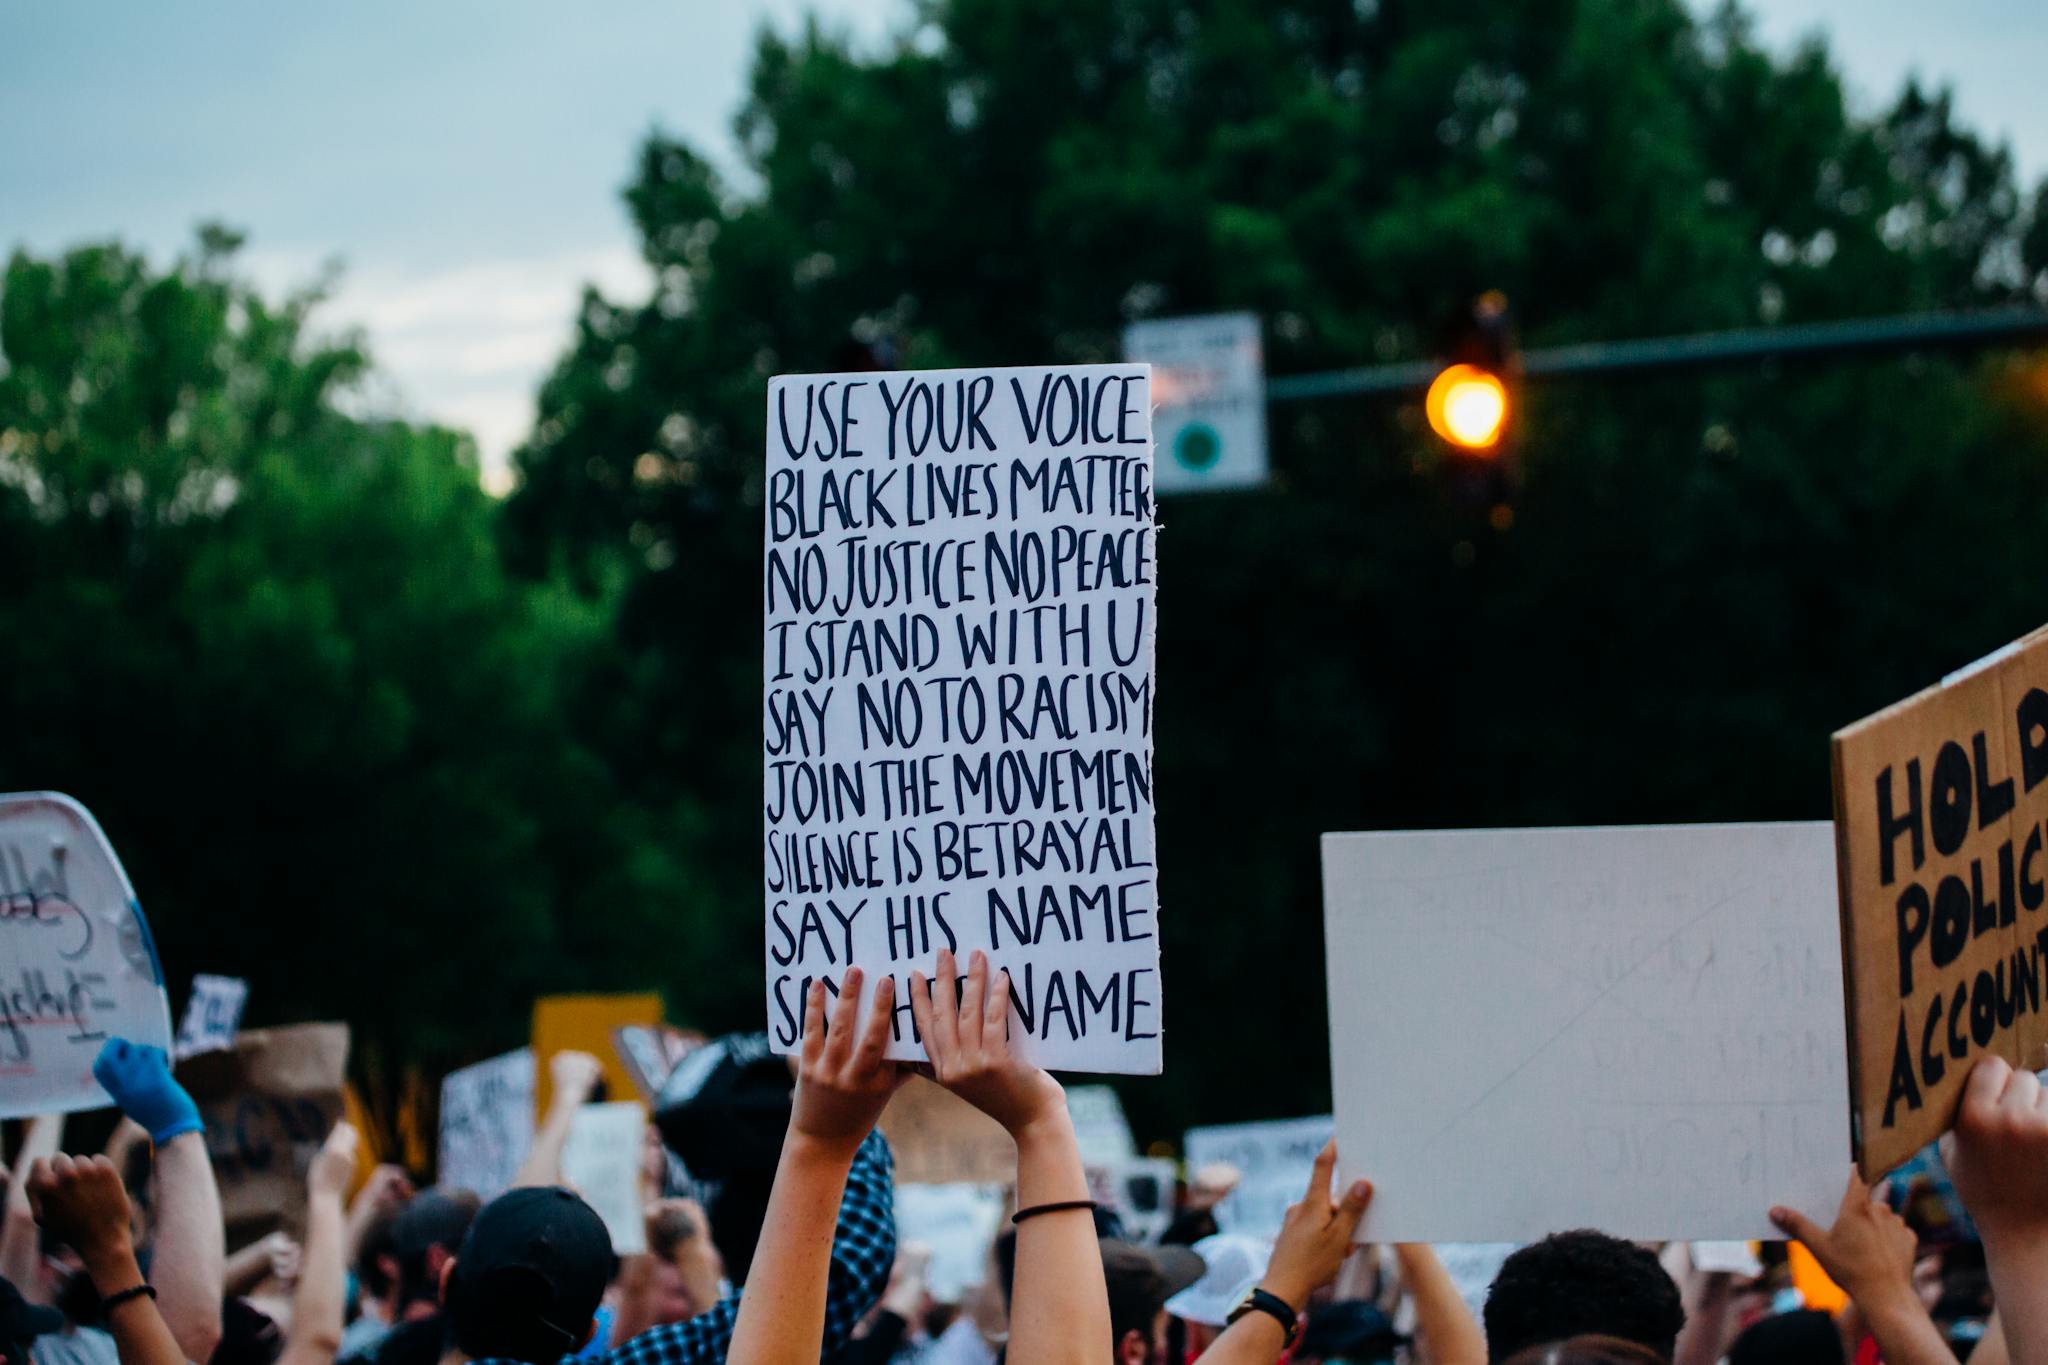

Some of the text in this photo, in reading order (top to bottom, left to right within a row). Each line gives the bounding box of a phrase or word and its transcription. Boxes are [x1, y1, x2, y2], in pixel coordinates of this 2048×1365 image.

[779, 374, 1146, 461] USE YOUR VOICE
[771, 456, 1151, 542] BLACK LIVES MATTER
[768, 525, 1150, 617] NO JUSTICE NO PEACE
[769, 597, 1143, 684] I STAND WITH U
[767, 672, 1149, 758] SAY NO TO RACISM
[767, 760, 865, 825] JOIN
[869, 754, 943, 821] THE
[1876, 687, 2048, 887] HOLD
[768, 817, 1152, 893] SILENCE IS BETRAYAL
[772, 880, 1152, 966] SAY HIS NAME
[1896, 815, 2048, 999] POLIC
[774, 974, 842, 1047] SA
[1001, 963, 1157, 1042] NAME
